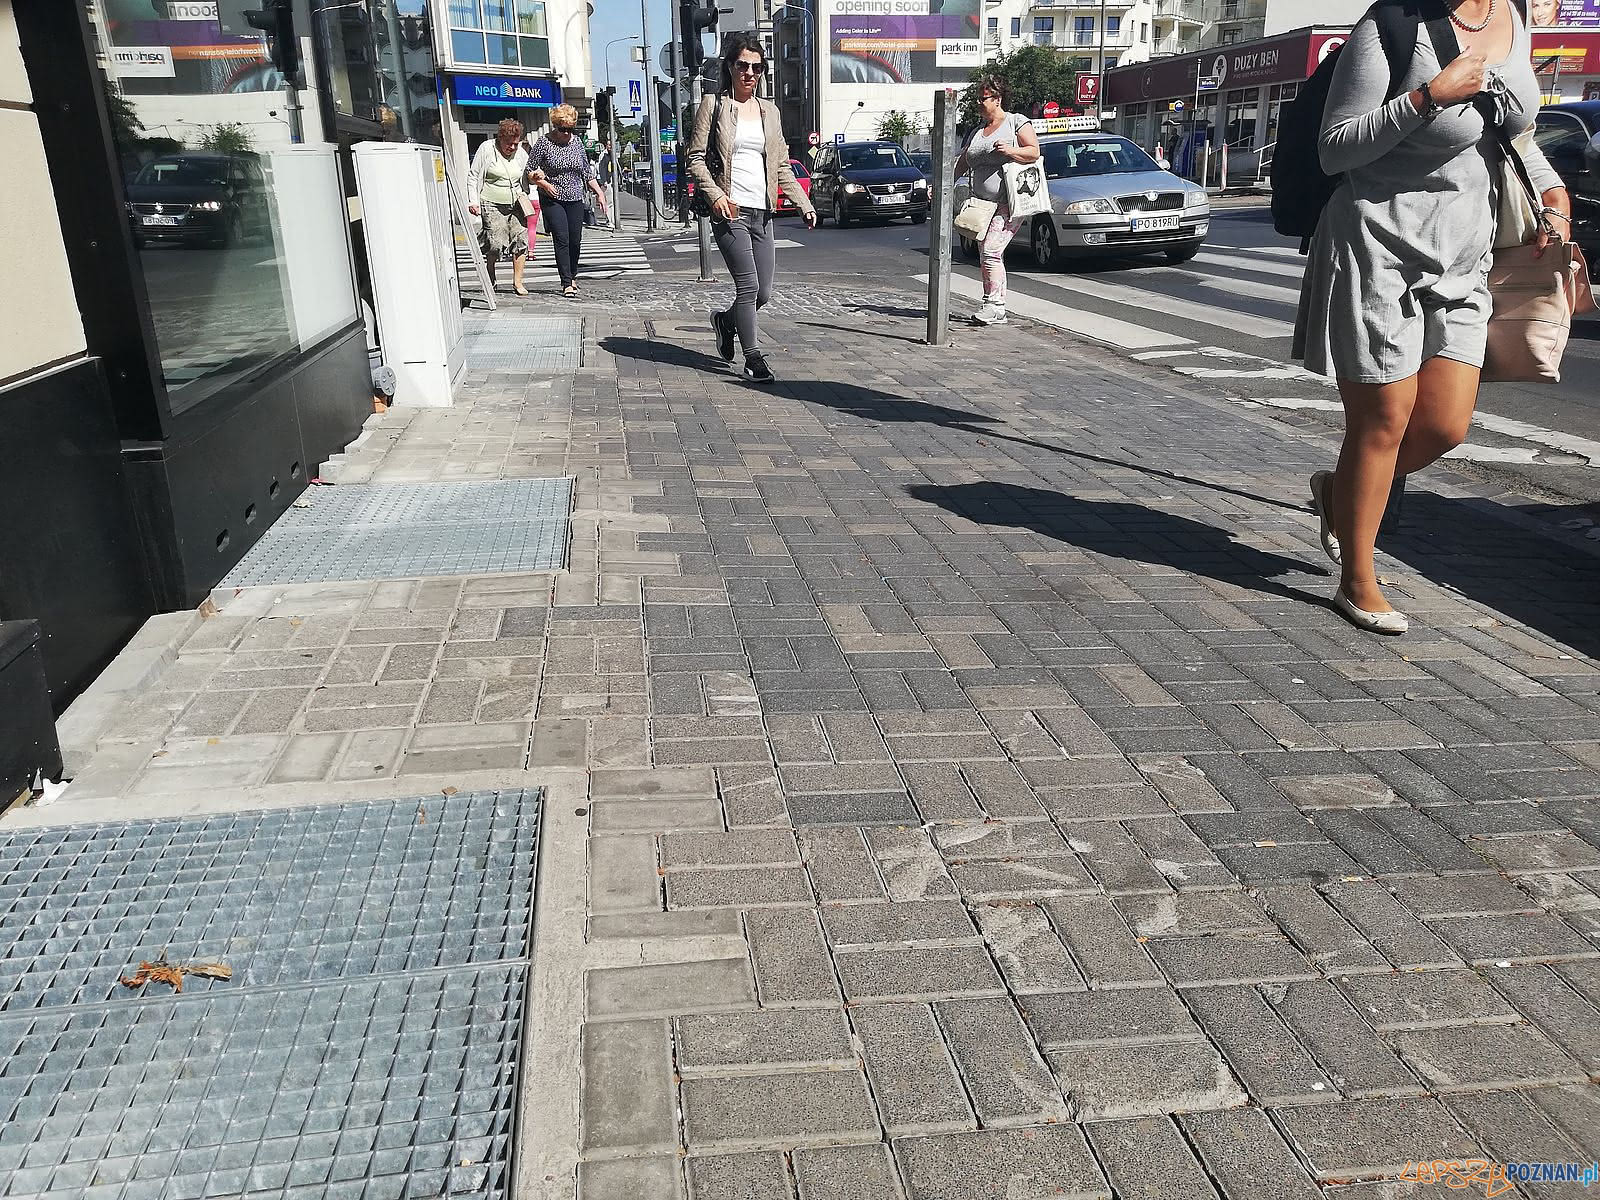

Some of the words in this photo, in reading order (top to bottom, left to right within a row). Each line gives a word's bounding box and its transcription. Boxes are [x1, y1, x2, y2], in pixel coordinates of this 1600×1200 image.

[836, 0, 892, 15] opening
[895, 0, 929, 12] soon
[941, 42, 961, 55] park
[963, 42, 977, 51] inn
[1234, 51, 1258, 71] DUŻY
[1260, 49, 1279, 66] BEN
[514, 87, 542, 99] BANK
[1137, 219, 1150, 229] PO
[1152, 217, 1178, 228] 819RU
